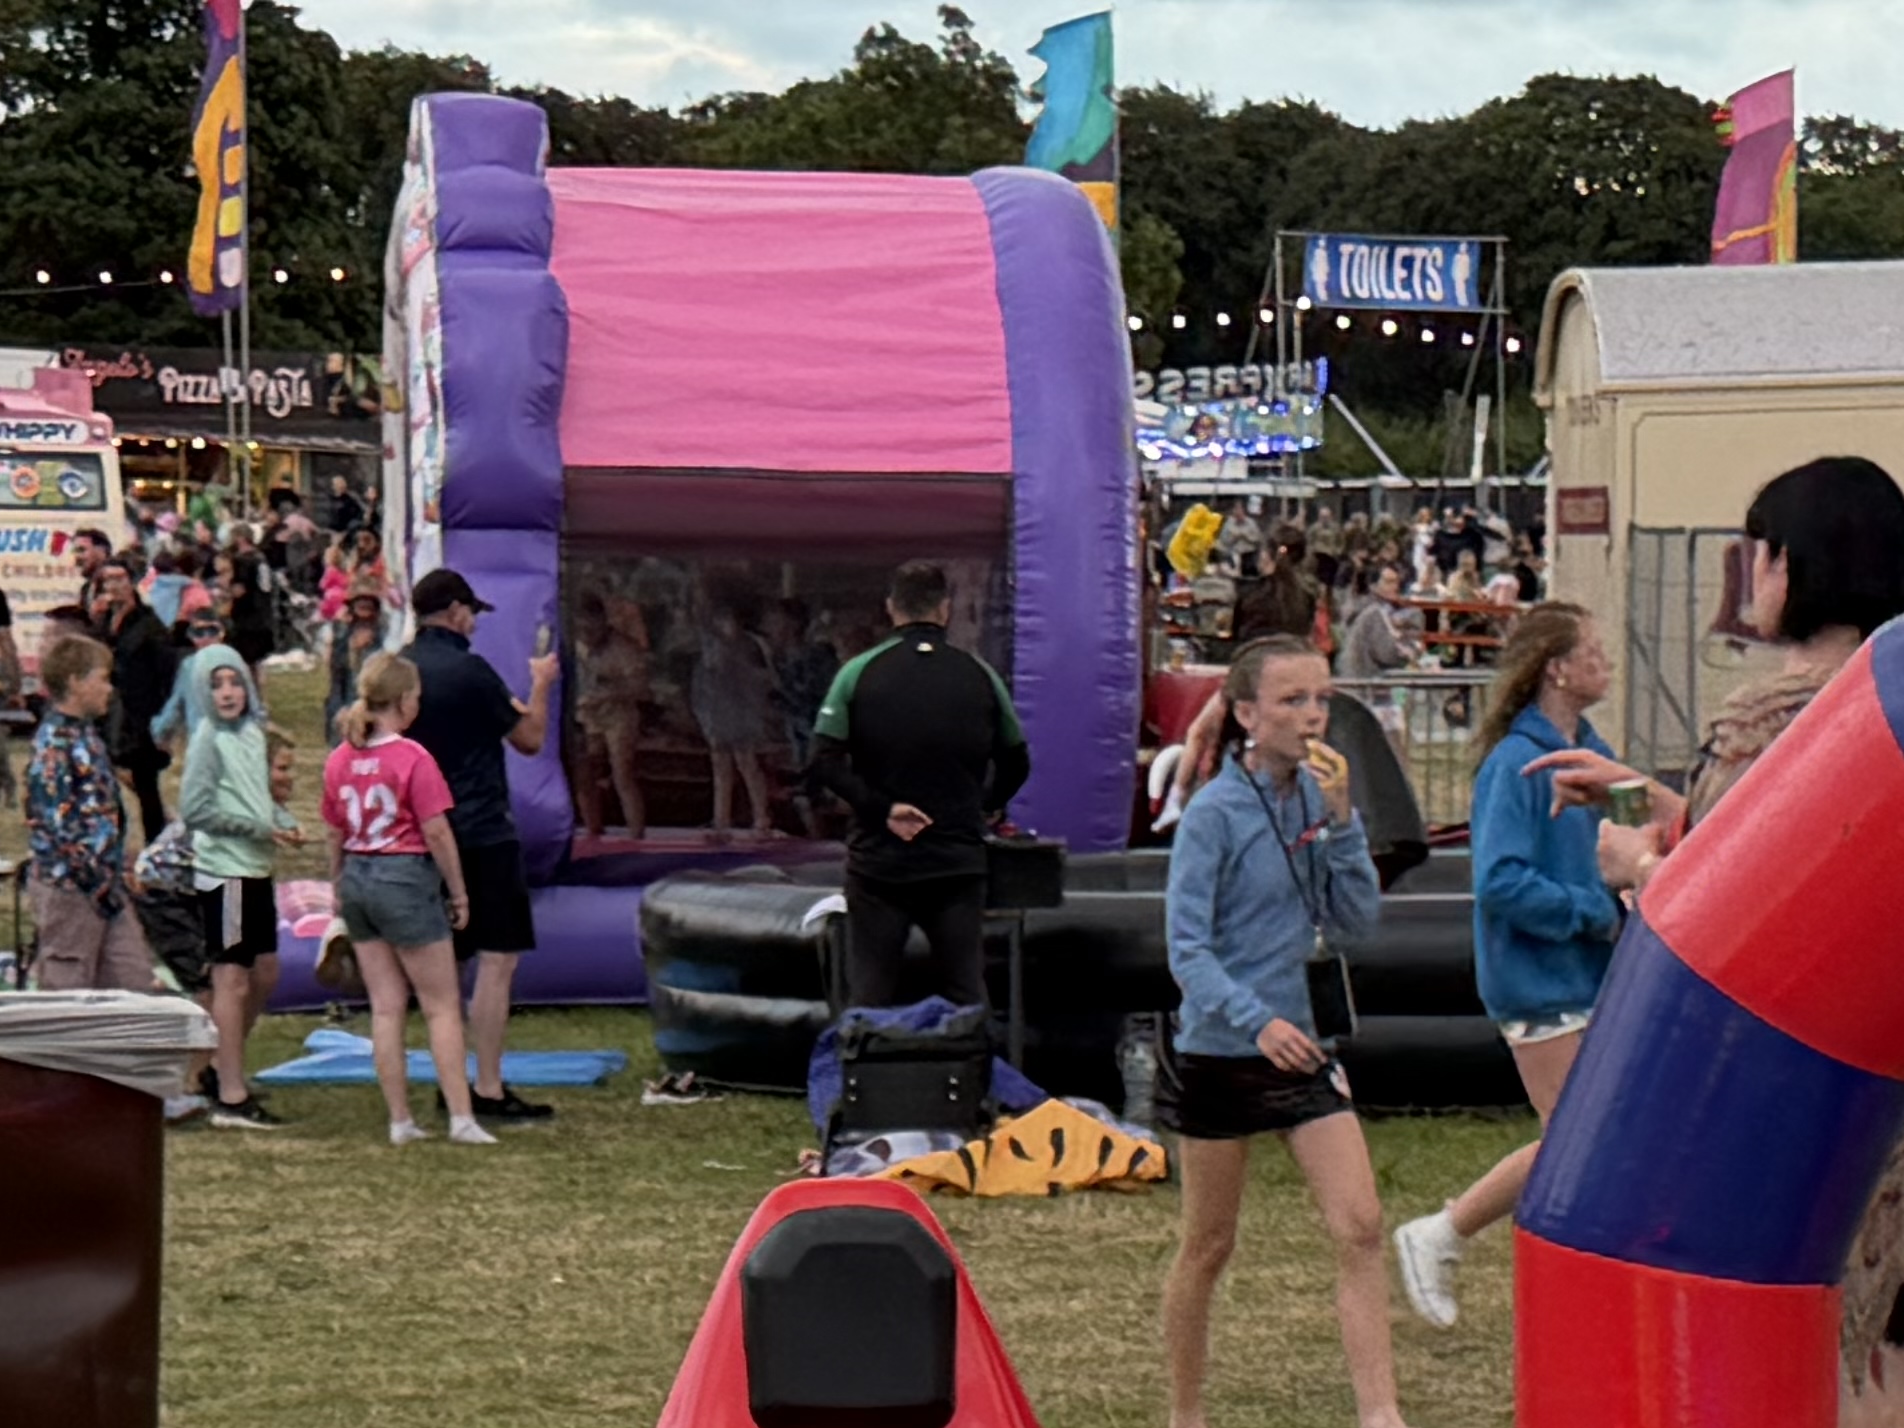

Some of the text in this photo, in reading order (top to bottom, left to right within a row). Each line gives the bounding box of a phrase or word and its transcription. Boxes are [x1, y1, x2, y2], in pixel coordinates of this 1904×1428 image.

[1339, 243, 1443, 302] TOILETS
[158, 366, 222, 402] PIZZA
[248, 367, 312, 418] PASTA
